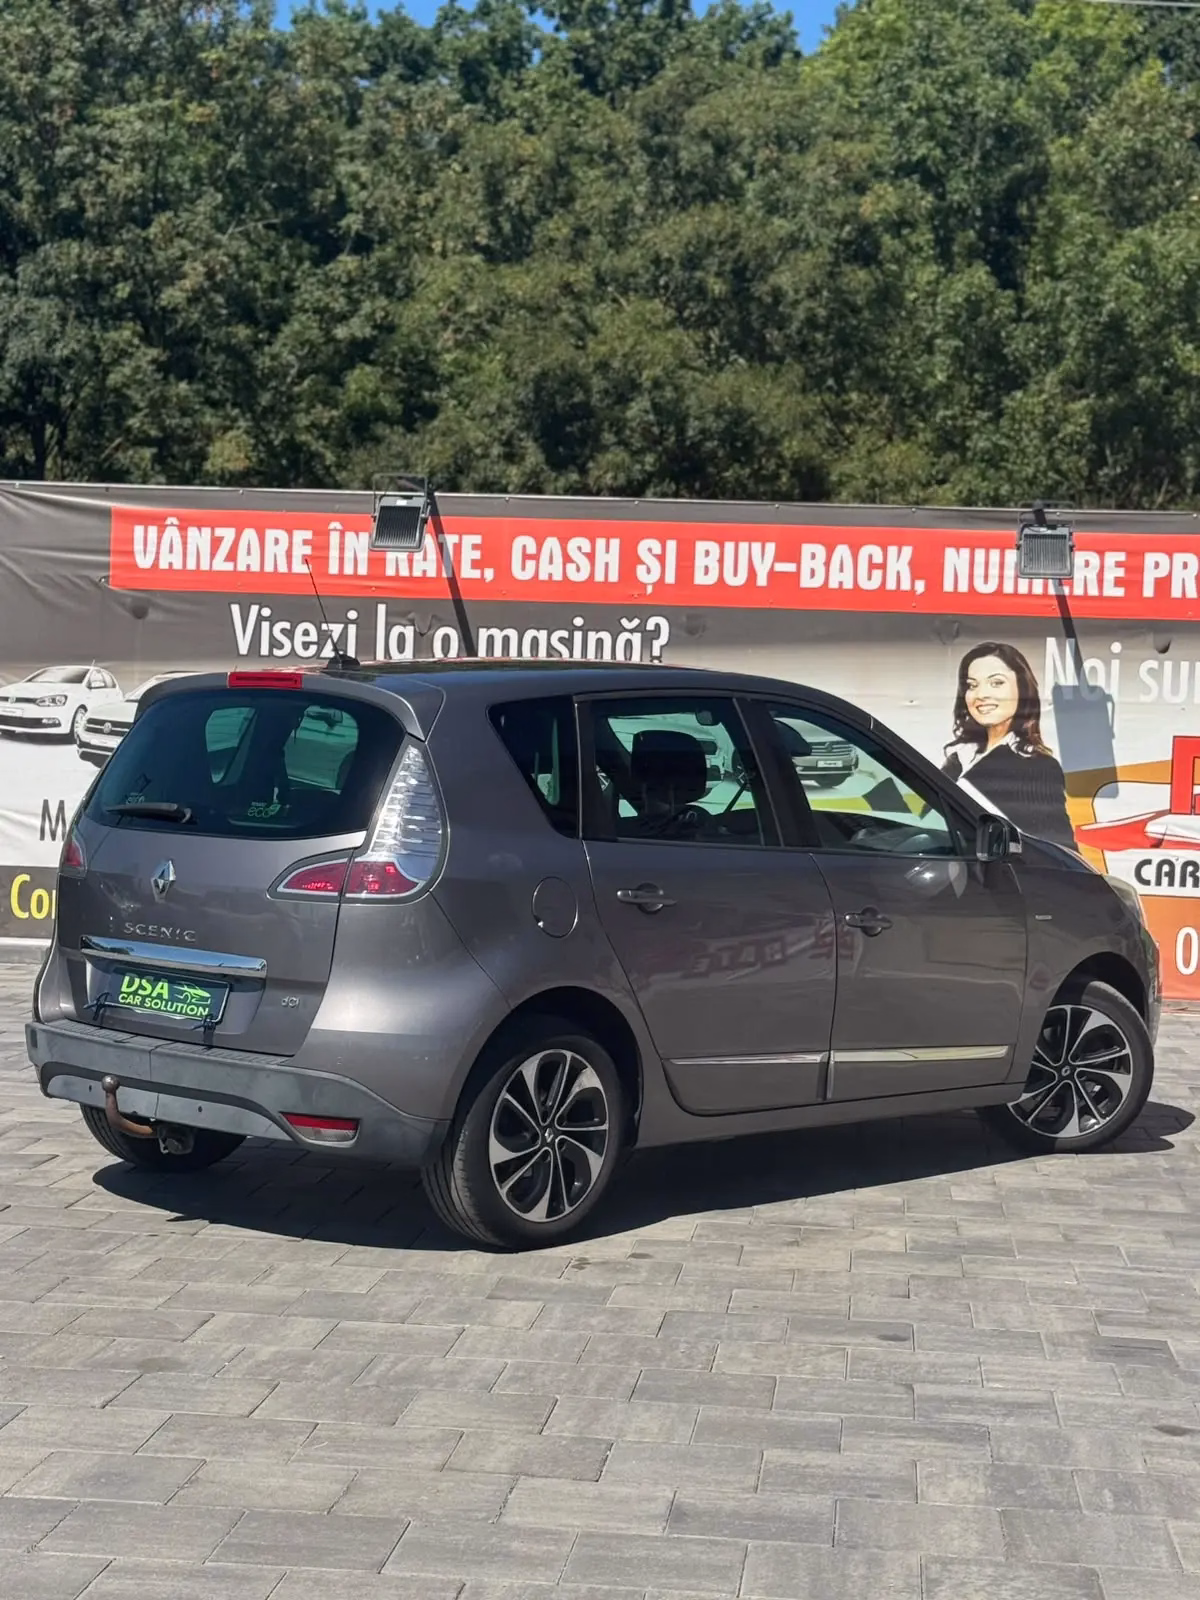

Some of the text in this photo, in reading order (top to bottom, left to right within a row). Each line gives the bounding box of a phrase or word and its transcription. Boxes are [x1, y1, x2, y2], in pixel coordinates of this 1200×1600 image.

[133, 516, 313, 574] VÂNZARE
[328, 521, 370, 577] ÎN
[511, 534, 621, 583] CASH
[229, 603, 360, 659] Visezi
[376, 603, 416, 661] la
[432, 626, 460, 660] o
[1043, 636, 1122, 704] Noi
[1134, 857, 1200, 890] CAR
[10, 873, 56, 920] Co
[123, 921, 197, 942] SCENIC
[118, 993, 210, 1017] CAR SOLUTION
[120, 973, 169, 1000] DSA
